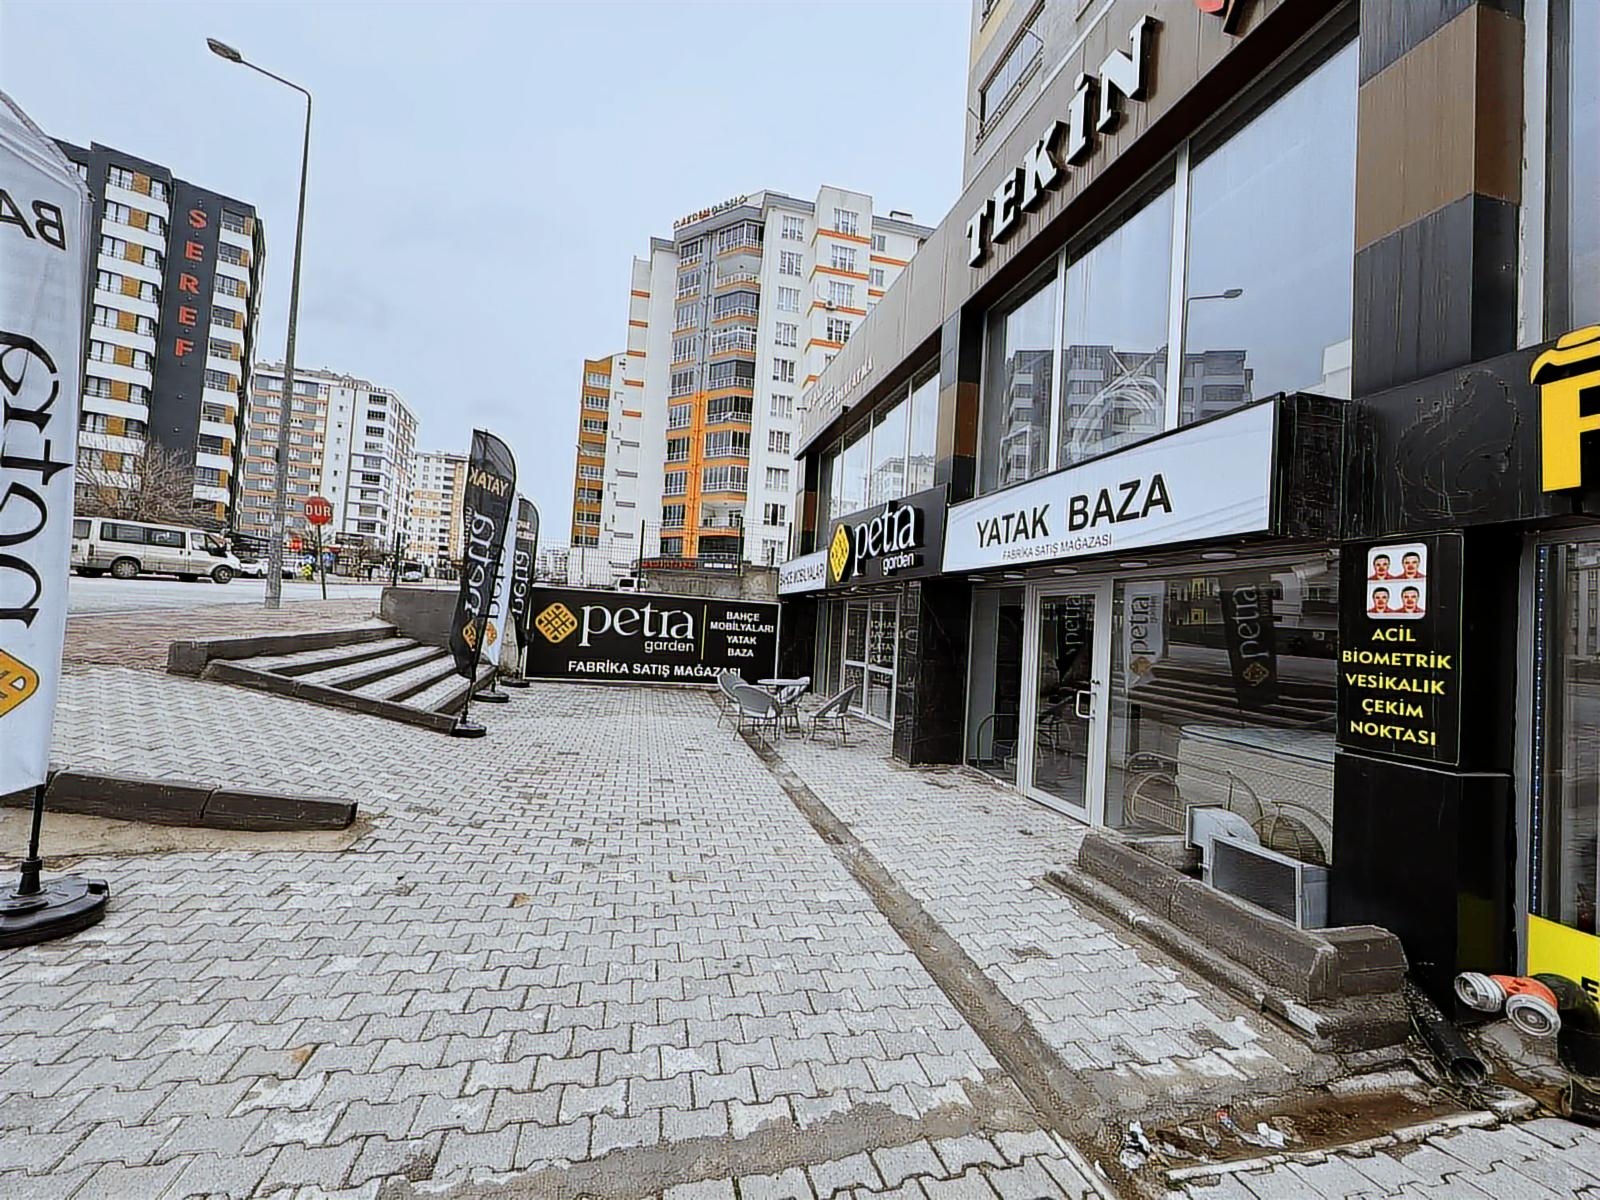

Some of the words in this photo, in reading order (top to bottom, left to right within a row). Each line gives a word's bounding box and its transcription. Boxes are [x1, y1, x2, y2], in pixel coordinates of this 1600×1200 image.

[966, 14, 1159, 268] TEKİN
[305, 504, 331, 517] DUR
[976, 504, 1050, 548] YATAK
[1068, 473, 1172, 532] BAZA
[852, 500, 916, 576] petra
[1003, 548, 1033, 560] FABRİKA
[1034, 543, 1059, 556] SATIŞ
[1060, 533, 1112, 551] MAĞAZASI
[882, 552, 915, 575] garden
[578, 601, 695, 647] petra
[710, 621, 774, 633] MOBİLYALARI
[726, 611, 760, 623] BAHÇE
[726, 635, 757, 646] YATAK
[1372, 624, 1416, 642] ACİL
[644, 640, 695, 654] garden
[727, 648, 754, 658] BAZA
[568, 659, 629, 674] FABRİKA
[632, 663, 670, 677] SATIŞ
[1342, 647, 1452, 670] BİOMETRİK
[1345, 672, 1446, 695] VESİKALIK
[1361, 698, 1424, 719] ÇEKİM
[1350, 720, 1436, 746] NOKTASI
